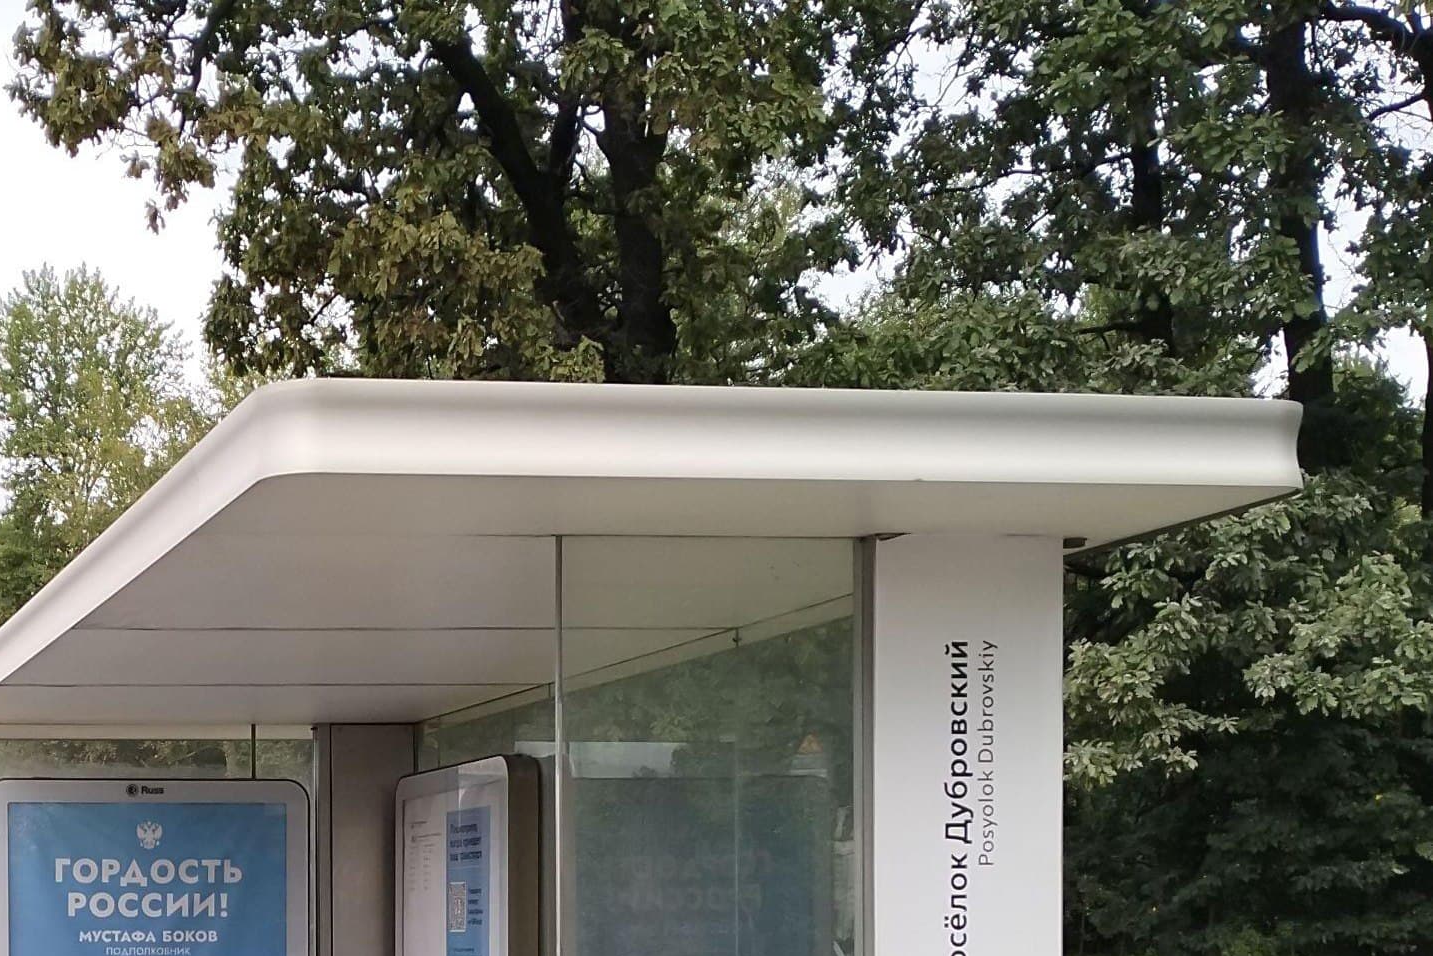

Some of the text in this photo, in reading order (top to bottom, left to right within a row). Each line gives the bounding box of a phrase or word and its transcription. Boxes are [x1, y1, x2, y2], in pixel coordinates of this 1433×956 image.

[944, 640, 974, 845] Дубровский
[976, 640, 998, 866] Posyolok Dubrovskiy
[54, 857, 243, 888] ГОРДОСТЬ
[67, 892, 230, 918] РОССИИ!
[78, 930, 219, 943] МУСТАФА БОКОВ
[105, 946, 191, 956] ПОДПОЛКОВНИК
